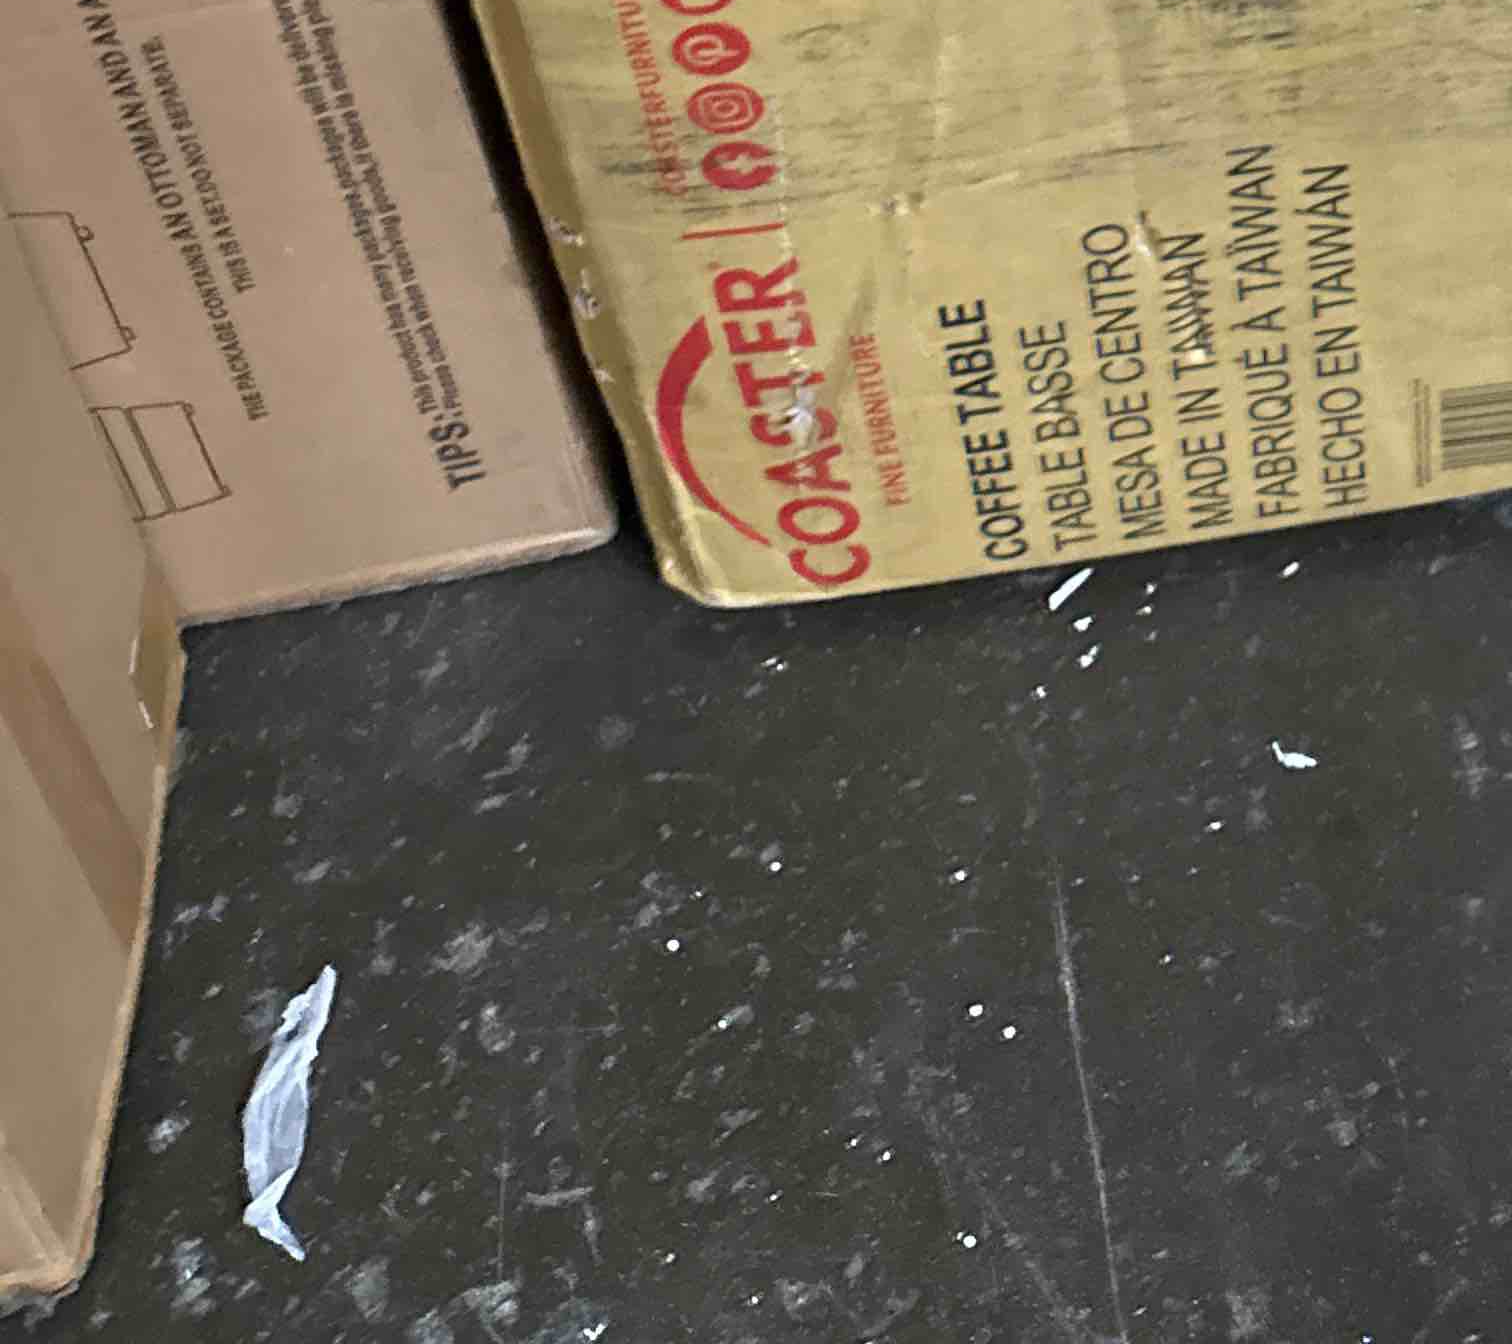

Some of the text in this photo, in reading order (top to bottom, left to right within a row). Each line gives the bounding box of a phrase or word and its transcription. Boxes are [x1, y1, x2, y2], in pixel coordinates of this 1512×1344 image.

[120, 102, 184, 209] OTTOMAN
[162, 212, 197, 240] AN
[212, 321, 256, 392] PACKAGE
[714, 256, 871, 585] COASTER
[848, 334, 912, 509] FINE FURNITURE
[938, 298, 1029, 562] COFFEE TABLE
[1019, 320, 1097, 552] TABLE BASSE
[1082, 223, 1168, 540] MESA DE CENTRO
[1158, 231, 1234, 531] MADE IN TAIWAN
[1234, 342, 1300, 519] FABRIQUÉ
[1316, 324, 1360, 380] EN
[428, 411, 487, 492] TIPS:
[1318, 385, 1368, 509] HECHO
